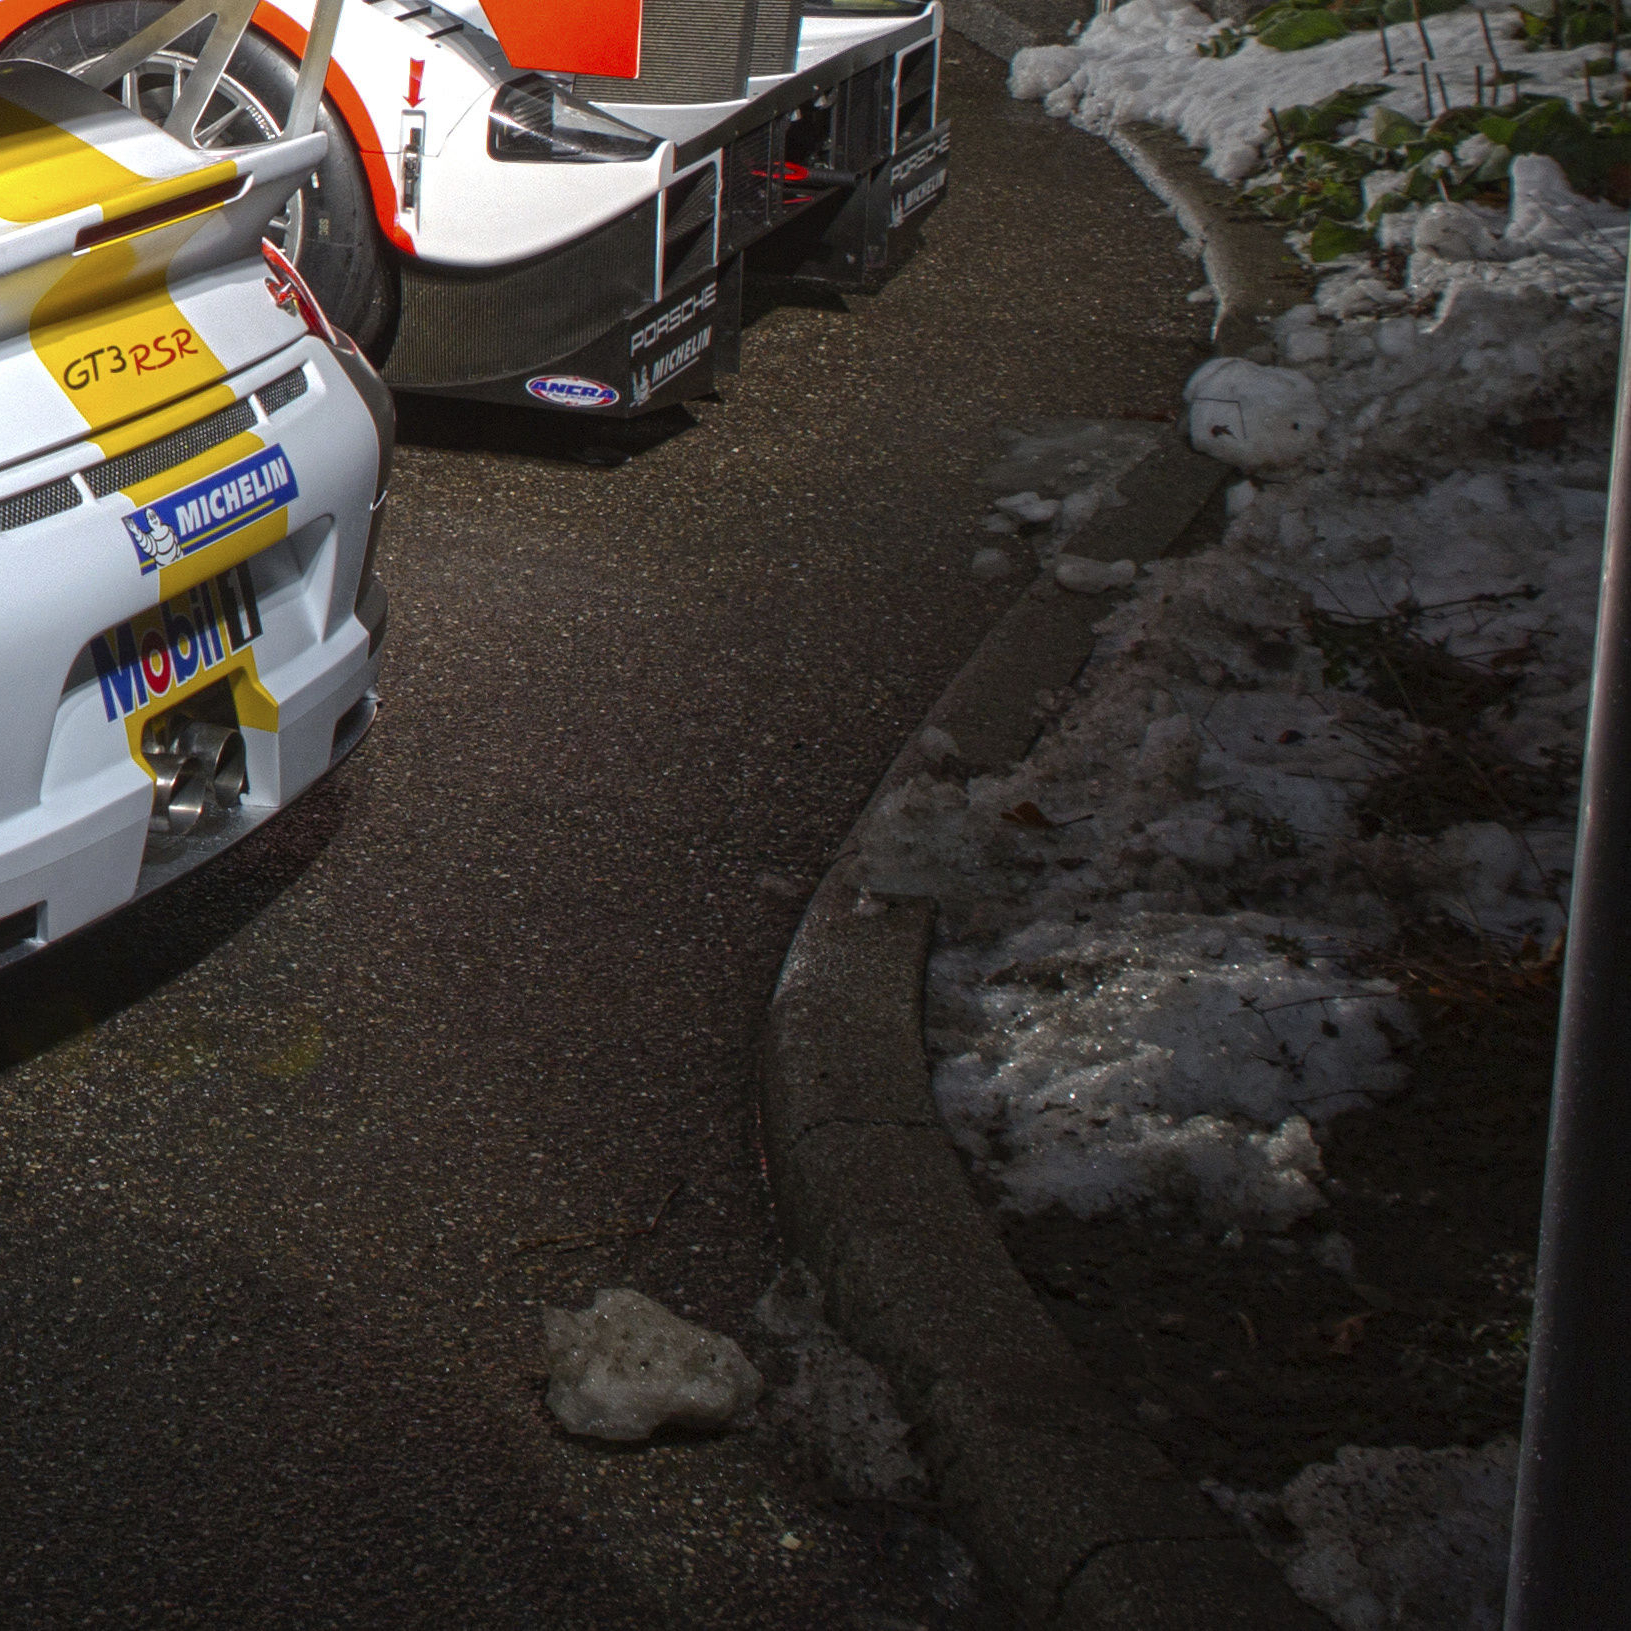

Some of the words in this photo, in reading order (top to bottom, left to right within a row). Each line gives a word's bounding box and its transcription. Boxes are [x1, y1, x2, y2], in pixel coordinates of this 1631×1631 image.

[630, 282, 717, 358] PORSCHE
[651, 325, 712, 384] MICHELIN
[63, 345, 127, 390] GT3
[128, 328, 198, 376] RSR
[530, 381, 615, 399] ANCRA
[175, 456, 289, 537] MICHELIN
[90, 582, 226, 723] Mobil
